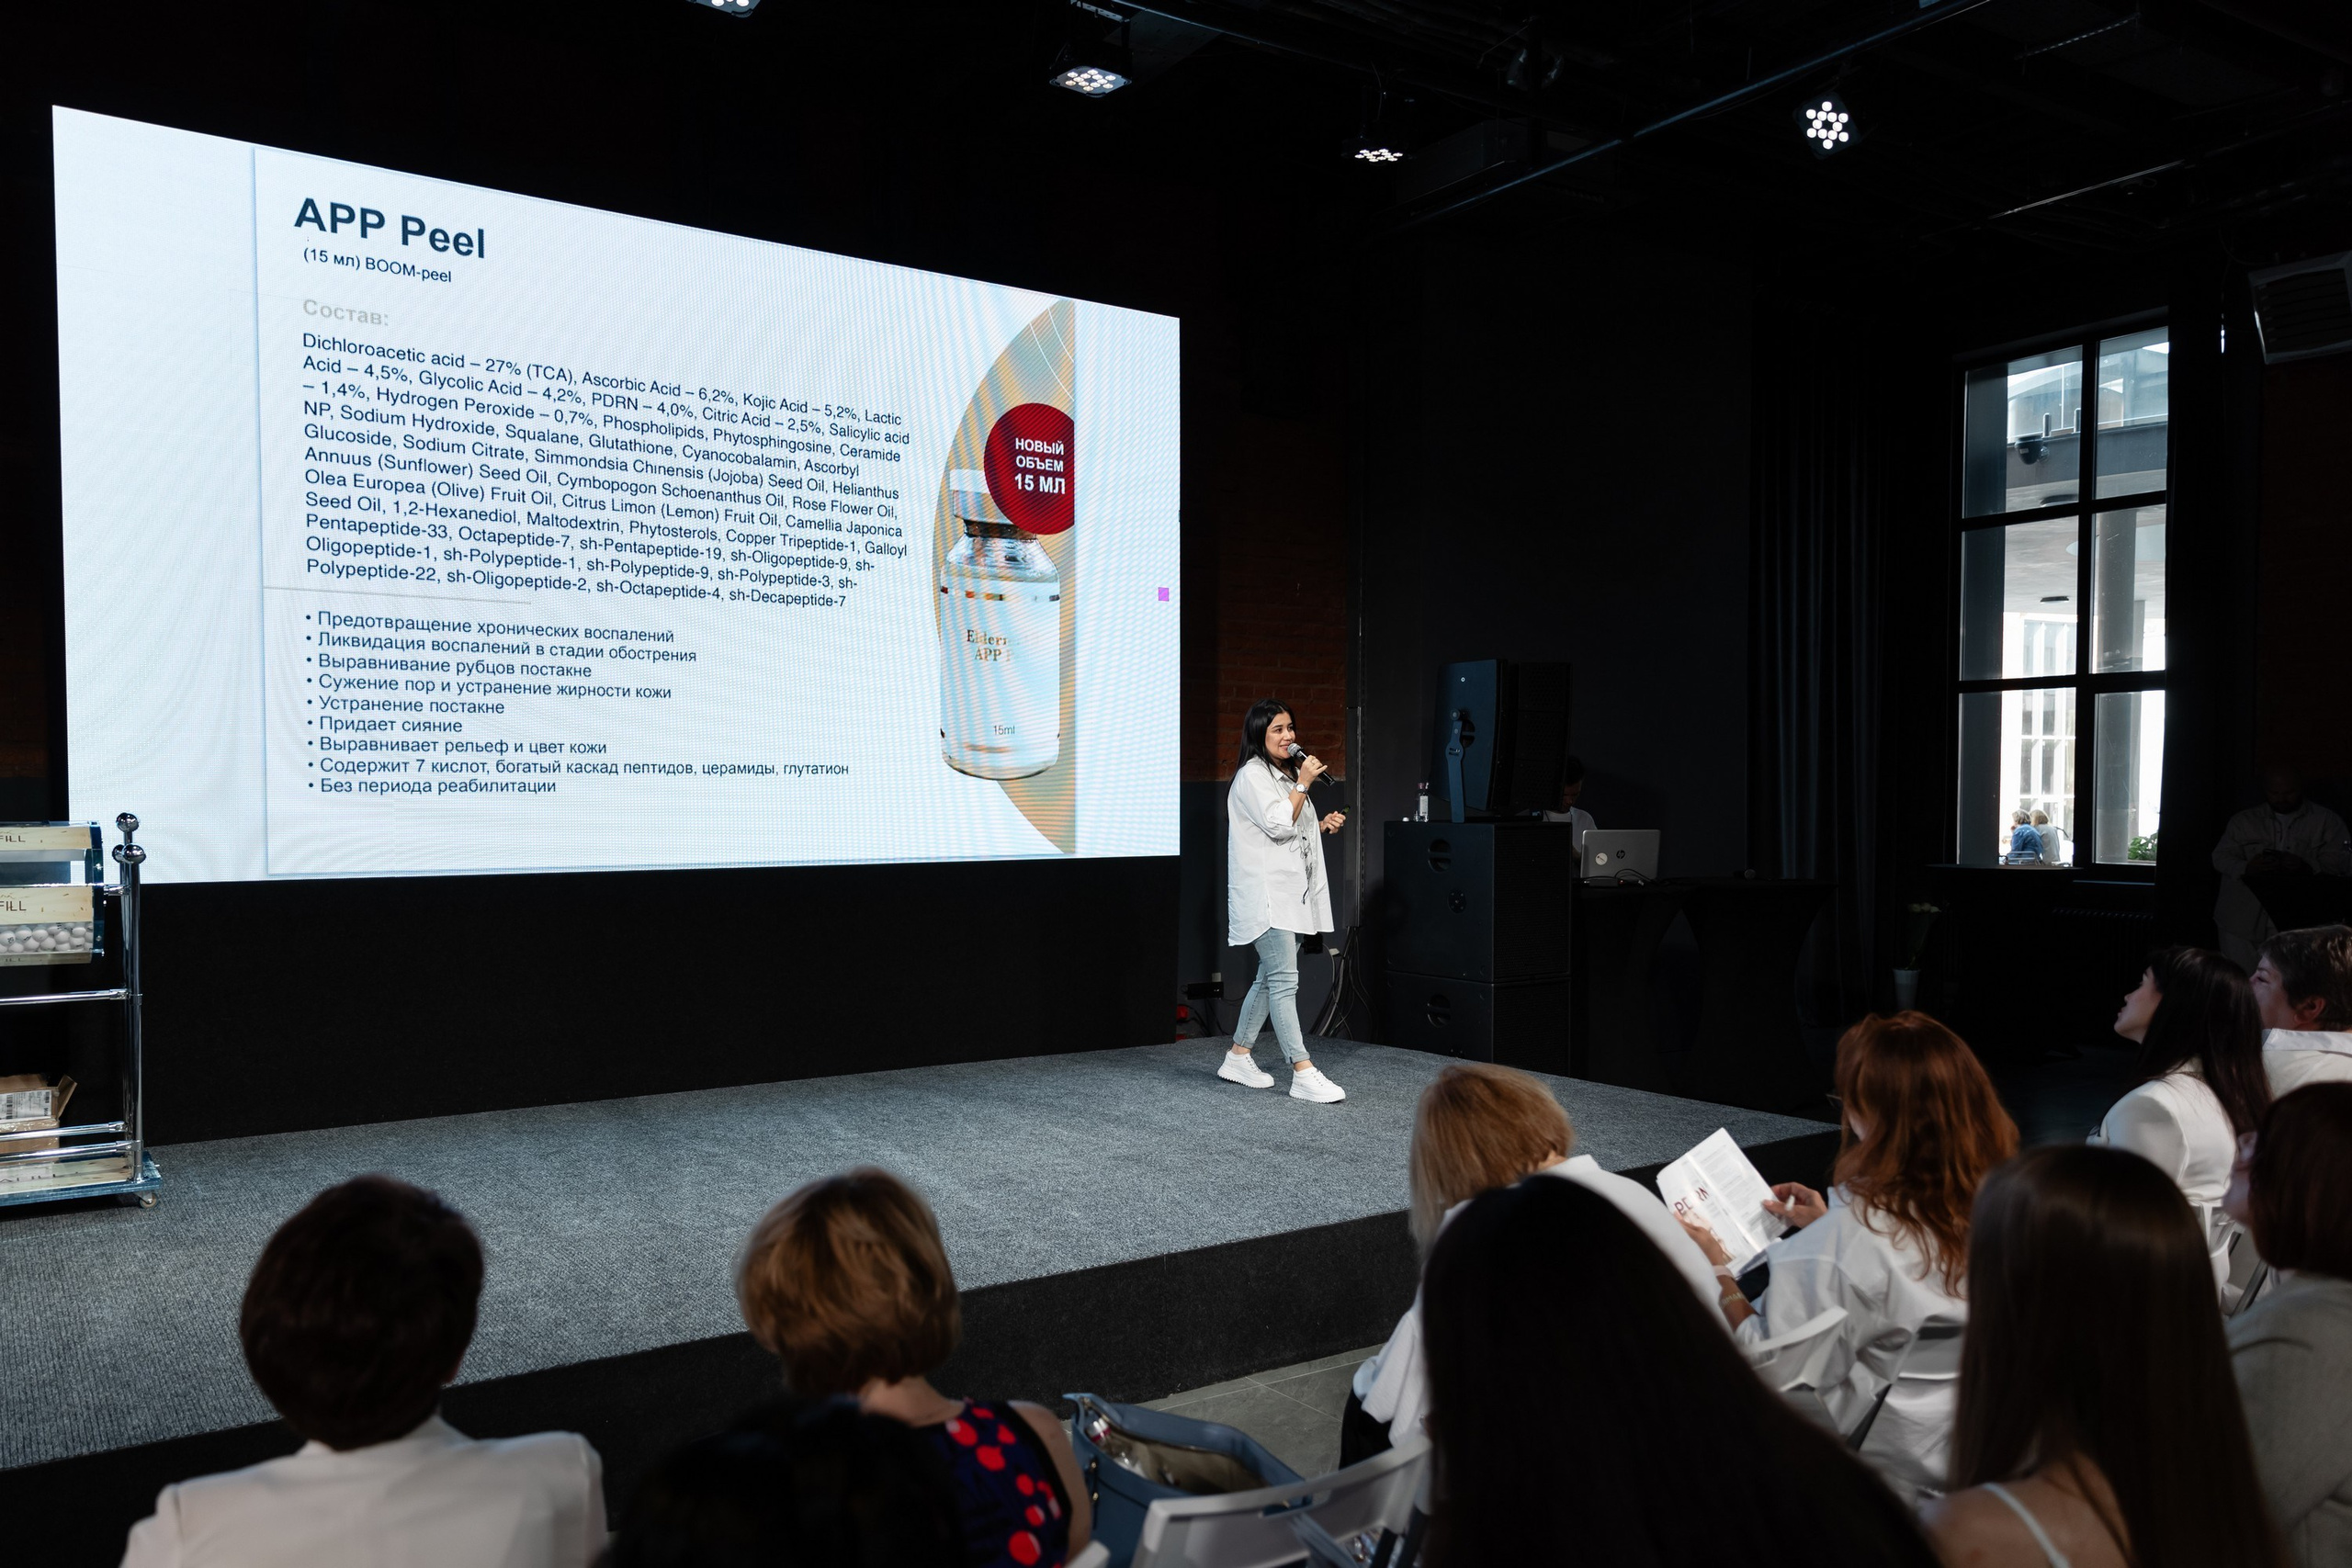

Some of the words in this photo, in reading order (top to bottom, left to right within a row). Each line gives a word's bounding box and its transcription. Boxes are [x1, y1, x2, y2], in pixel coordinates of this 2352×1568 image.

[294, 197, 386, 238] APP
[401, 215, 484, 259] Peel
[304, 248, 328, 263] (15
[334, 254, 360, 270] мл)
[366, 256, 451, 283] BOOM-peel
[303, 299, 388, 325] Состав:
[303, 333, 425, 363] Dichloroacetic
[431, 354, 464, 368] acid
[485, 358, 521, 376] 27%
[526, 364, 577, 386] (TCA),
[582, 371, 646, 392] Ascorbic
[650, 380, 680, 397] Acid
[698, 387, 738, 407] 6,2%,
[743, 393, 775, 412] Kojic
[779, 398, 808, 413] Acid
[824, 404, 860, 423] 5,2%,
[865, 409, 901, 425] Lactic
[303, 355, 341, 373] Acid
[364, 364, 412, 384] 4,5%,
[419, 369, 483, 391] Glycolic
[488, 379, 522, 396] Acid
[542, 387, 585, 406] 4,2%,
[592, 392, 638, 411] PDRN
[657, 401, 696, 420] 4,0%,
[702, 406, 738, 423] Citric
[741, 412, 770, 427] Acid
[787, 417, 824, 436] 2,5%,
[829, 423, 880, 442] Salicylic
[884, 432, 910, 445] acid
[322, 380, 369, 401] 1,4%,
[377, 387, 458, 412] Hydrogen
[465, 397, 534, 419] Peroxide
[554, 409, 597, 428] 0,7%,
[604, 414, 707, 442] Phospholipids,
[713, 428, 835, 457] Phytosphingosine,
[840, 443, 900, 462] Ceramide
[304, 400, 334, 419] NP,
[341, 404, 406, 426] Sodium
[413, 413, 499, 438] Hydroxide,
[505, 423, 582, 447] Squalane,
[588, 434, 677, 458] Glutathione,
[683, 444, 800, 471] Cyanocobalamin,
[804, 458, 859, 479] Ascorbyl
[1015, 437, 1064, 456] НОВЫЙ
[304, 423, 396, 449] Glucoside,
[403, 434, 466, 454] Sodium
[472, 441, 528, 463] Citrate,
[535, 448, 628, 472] Simmondsia
[708, 468, 763, 489] (Jojoba)
[768, 473, 802, 490] Seed
[807, 478, 828, 494] Oil,
[832, 480, 899, 500] Helianthus
[1015, 455, 1064, 472] ОБЪЕМ
[305, 446, 371, 467] Annuus
[379, 454, 473, 479] (Sunflower)
[480, 463, 520, 481] Seed
[526, 468, 550, 486] Oil,
[557, 471, 657, 496] Cymbopogon
[662, 482, 761, 505] Schoenanthus
[765, 492, 786, 509] Oil,
[793, 495, 826, 512] Rose
[831, 499, 873, 515] Flower
[876, 504, 897, 520] Oil,
[1014, 473, 1035, 491] 15
[1038, 475, 1066, 494] МЛ
[305, 468, 346, 487] Olea
[353, 473, 425, 495] Europea
[432, 481, 484, 502] (Olive)
[491, 486, 526, 503] Fruit
[531, 491, 556, 508] Oil,
[562, 493, 606, 511] Citrus
[611, 498, 656, 514] Limon
[661, 503, 718, 524] (Lemon)
[724, 508, 754, 525] Fruit
[759, 512, 781, 528] Oil,
[786, 514, 842, 532] Camellia
[846, 521, 902, 537] Japonica
[306, 491, 351, 509] Seed
[357, 496, 386, 513] Oil,
[393, 501, 520, 525] 1,2-Hexanediol,
[526, 511, 623, 534] Maltodextrin,
[629, 520, 720, 542] Phytosterols,
[725, 528, 776, 547] Copper
[779, 533, 860, 554] Tripeptide-1,
[865, 540, 907, 558] Galloyl
[307, 513, 451, 541] Pentapeptide-33,
[458, 525, 573, 550] Octapeptide-7,
[580, 536, 726, 562] sh-Pentapeptide-19,
[730, 548, 851, 571] sh-Oligopeptide-9,
[855, 559, 875, 571] sh-
[306, 536, 436, 561] Oligopeptide-1,
[444, 547, 581, 571] sh-Polypeptide-1,
[587, 558, 713, 581] sh-Polypeptide-9,
[718, 568, 833, 590] sh-Polypeptide-3,
[839, 577, 857, 589] sh-
[308, 558, 440, 584] Polypeptide-22,
[447, 569, 591, 593] sh-Oligopeptide-2,
[596, 580, 724, 601] sh-Octapeptide-4,
[729, 588, 846, 608] sh-Decapeptide-7
[319, 611, 471, 633] Предотвращение
[477, 623, 579, 637] хронических
[584, 627, 673, 642] воспалений
[318, 631, 425, 651] Ликвидация
[432, 640, 529, 654] воспалений
[537, 645, 544, 655] в
[549, 646, 604, 660] стадии
[609, 646, 696, 663] обострения
[319, 653, 450, 672] Выравнивание
[457, 660, 514, 677] рубцов
[521, 664, 592, 677] постакне
[319, 673, 399, 692] Сужение
[405, 680, 435, 694] пор
[441, 682, 450, 692] и
[457, 682, 551, 696] устранение
[556, 685, 630, 699] жирности
[636, 687, 672, 698] кожи
[320, 695, 424, 714] Устранение
[430, 701, 504, 714] постакне
[320, 716, 396, 733] Придает
[401, 720, 462, 732] сияние
[993, 725, 1015, 736] 15ml
[320, 737, 438, 754] Выравнивает
[445, 739, 508, 756] рельеф
[514, 742, 524, 752] и
[529, 742, 564, 755] цвет
[570, 743, 606, 754] кожи
[320, 757, 409, 775] Содержит
[416, 759, 424, 772] 7
[431, 761, 490, 773] кислот,
[495, 760, 560, 773] богатый
[567, 762, 618, 775] каскад
[623, 763, 696, 775] пептидов,
[702, 764, 778, 777] церамиды,
[784, 764, 849, 778] глутатион
[321, 778, 352, 793] Без
[358, 781, 431, 795] периода
[437, 778, 555, 795] реабилитации
